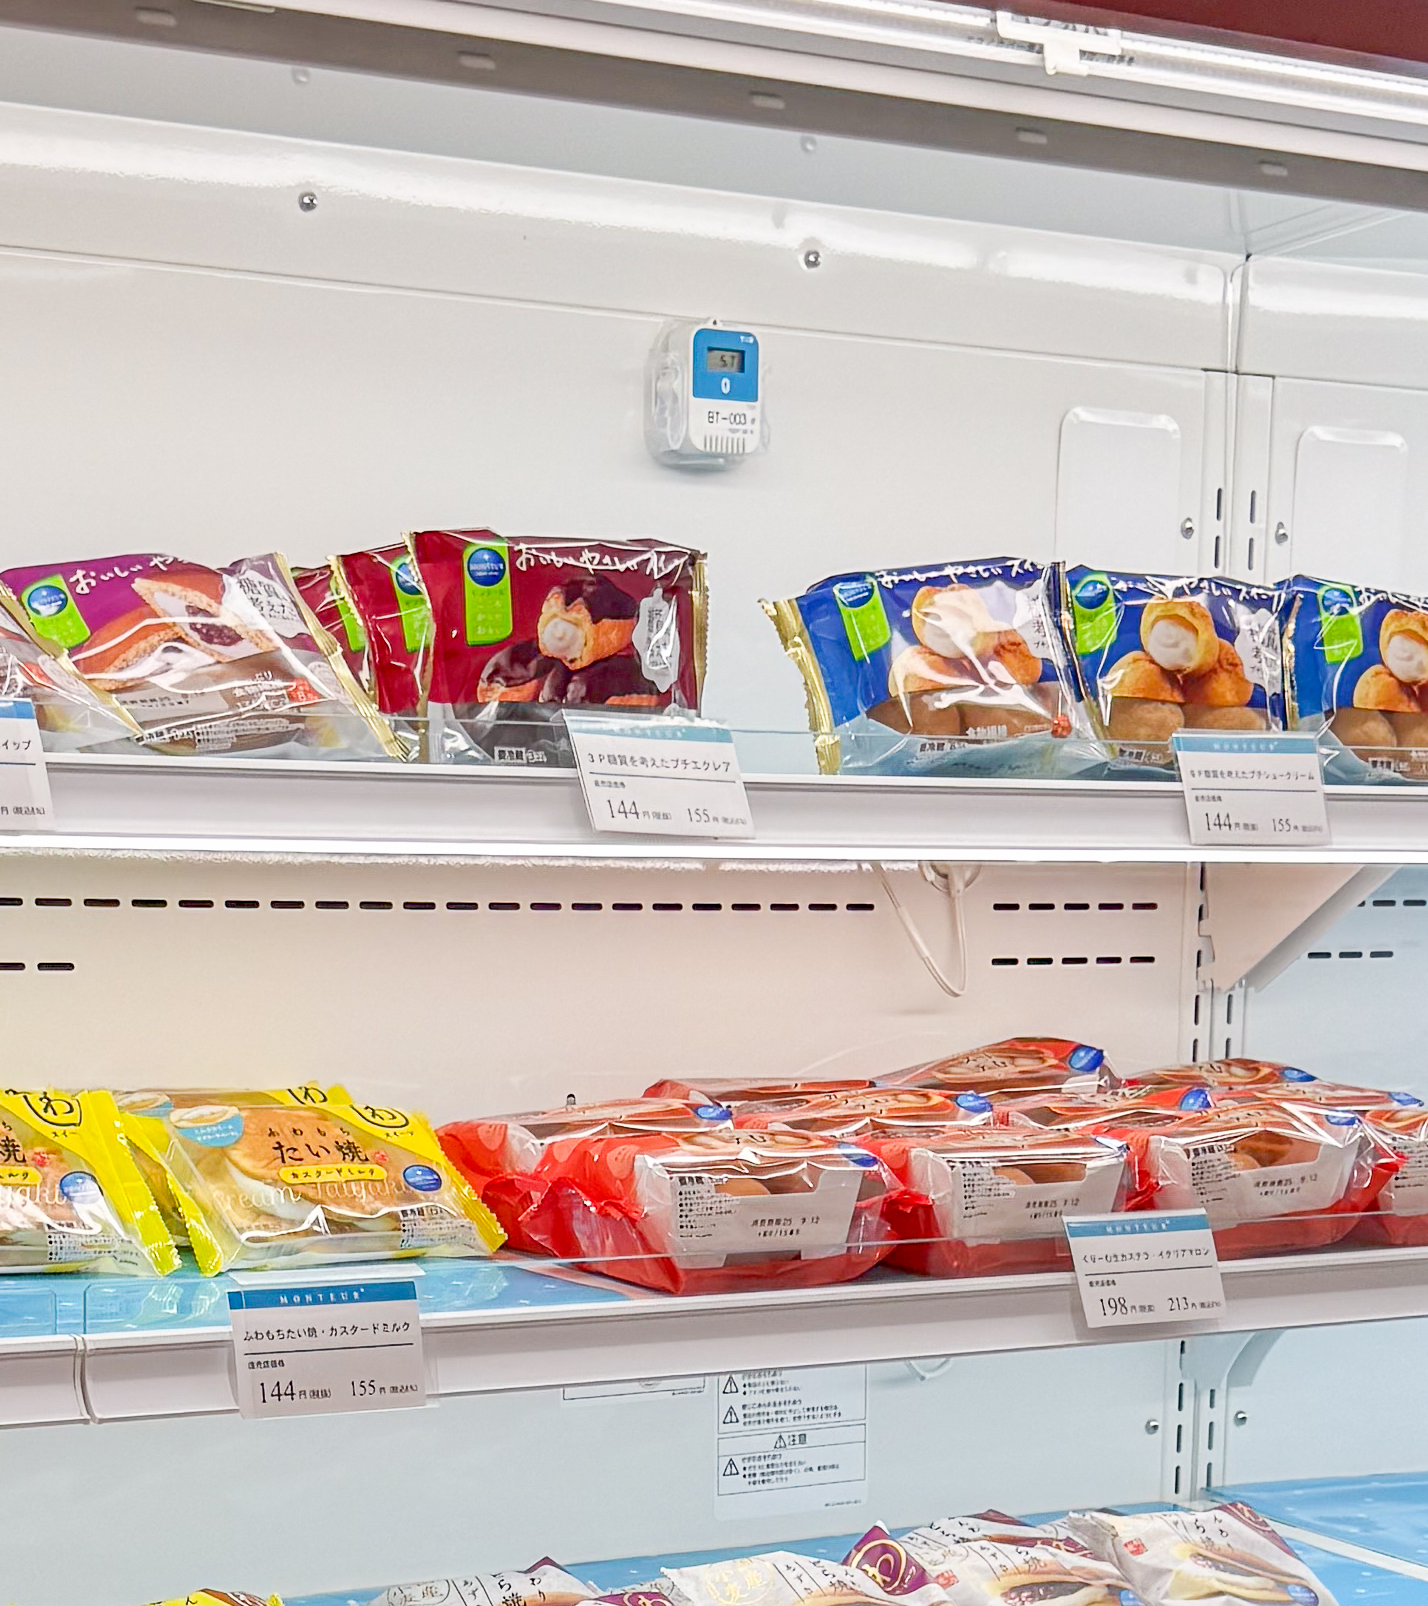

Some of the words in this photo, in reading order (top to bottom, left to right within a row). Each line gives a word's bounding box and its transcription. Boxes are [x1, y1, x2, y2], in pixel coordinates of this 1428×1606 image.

[606, 797, 641, 821] 144
[685, 806, 711, 825] 155
[1204, 811, 1233, 832] 144
[1271, 816, 1293, 834] 155
[272, 1140, 370, 1165] たい焼
[1099, 1296, 1129, 1317] 198
[1167, 1296, 1190, 1312] 213
